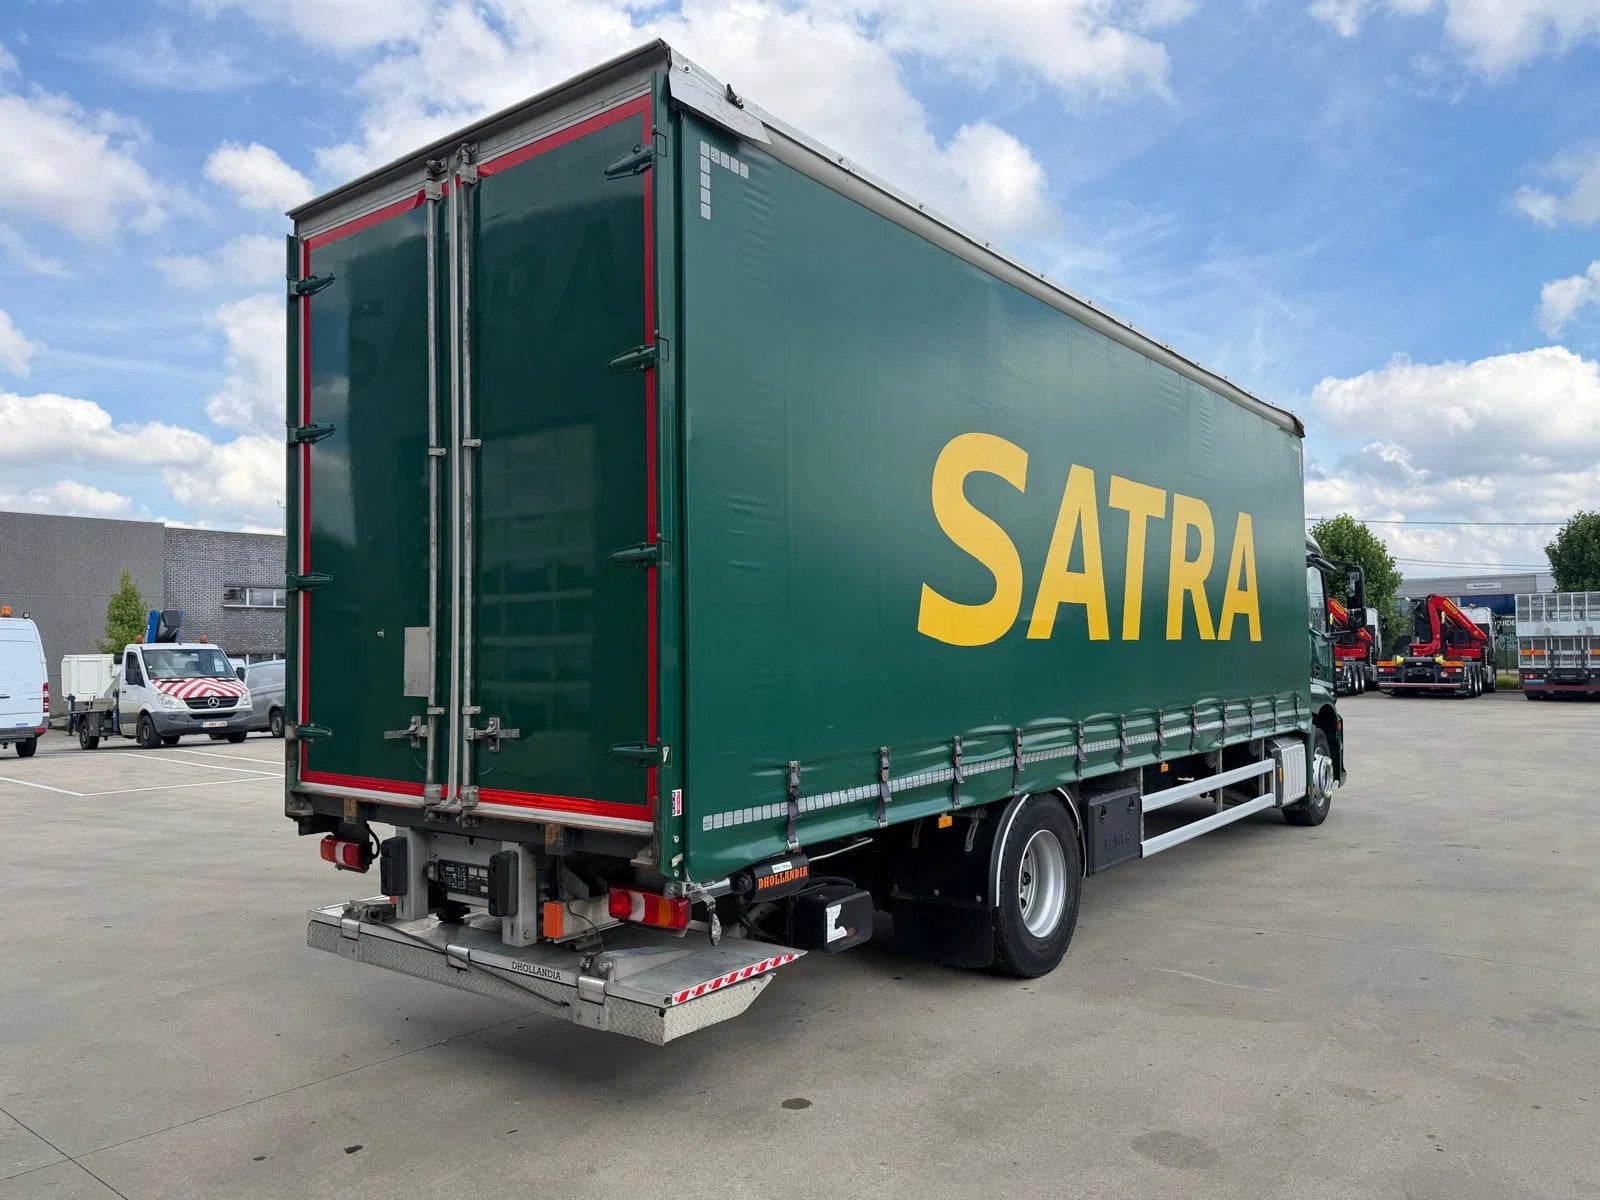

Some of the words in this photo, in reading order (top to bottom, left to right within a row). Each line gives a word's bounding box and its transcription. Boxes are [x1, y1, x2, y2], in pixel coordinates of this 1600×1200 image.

[917, 432, 1262, 647] SATRA
[757, 865, 808, 890] DHOLLANDIA
[511, 961, 561, 980] DHOLLANDIA
